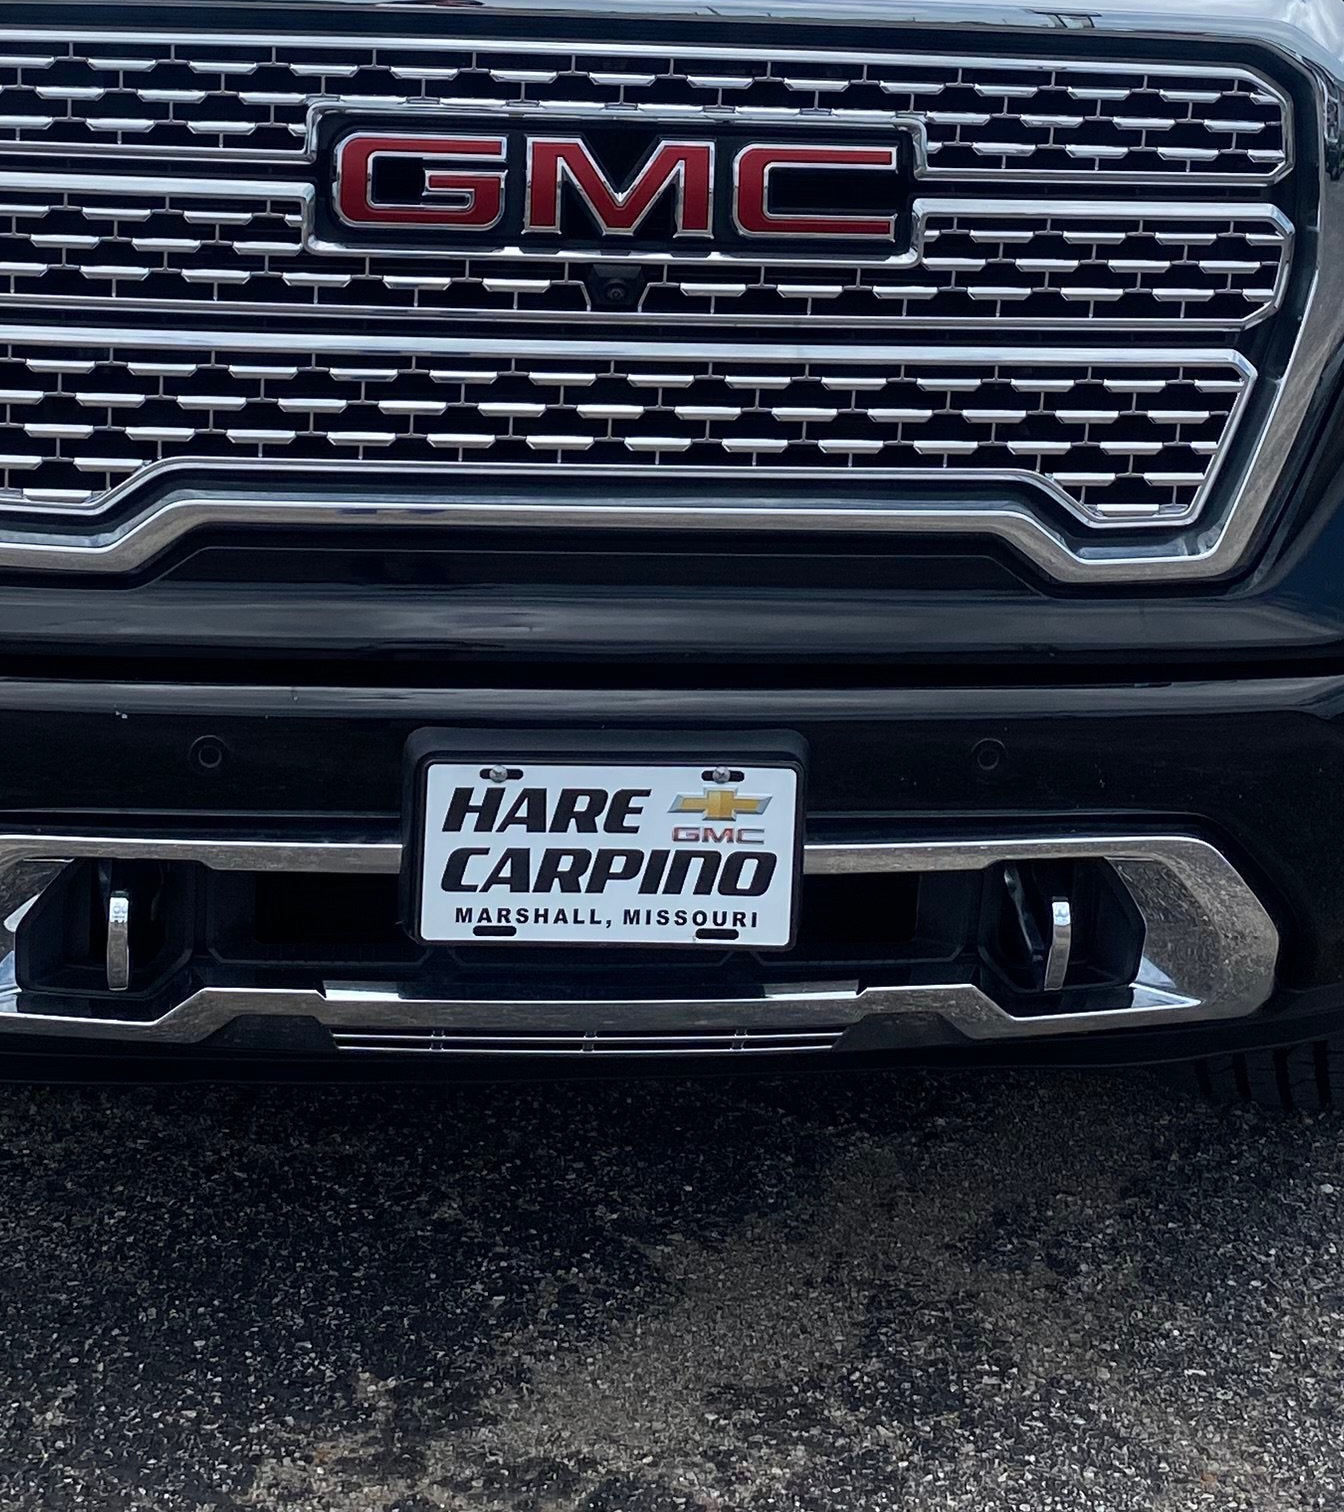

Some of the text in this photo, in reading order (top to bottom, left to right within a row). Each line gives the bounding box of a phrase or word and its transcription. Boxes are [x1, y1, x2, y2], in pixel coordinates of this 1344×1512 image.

[332, 131, 900, 243] GMC
[441, 786, 652, 835] HARE
[672, 826, 766, 845] GMC
[440, 846, 778, 898] CARPINO
[455, 907, 758, 929] MARSHALL, MISSOURI
